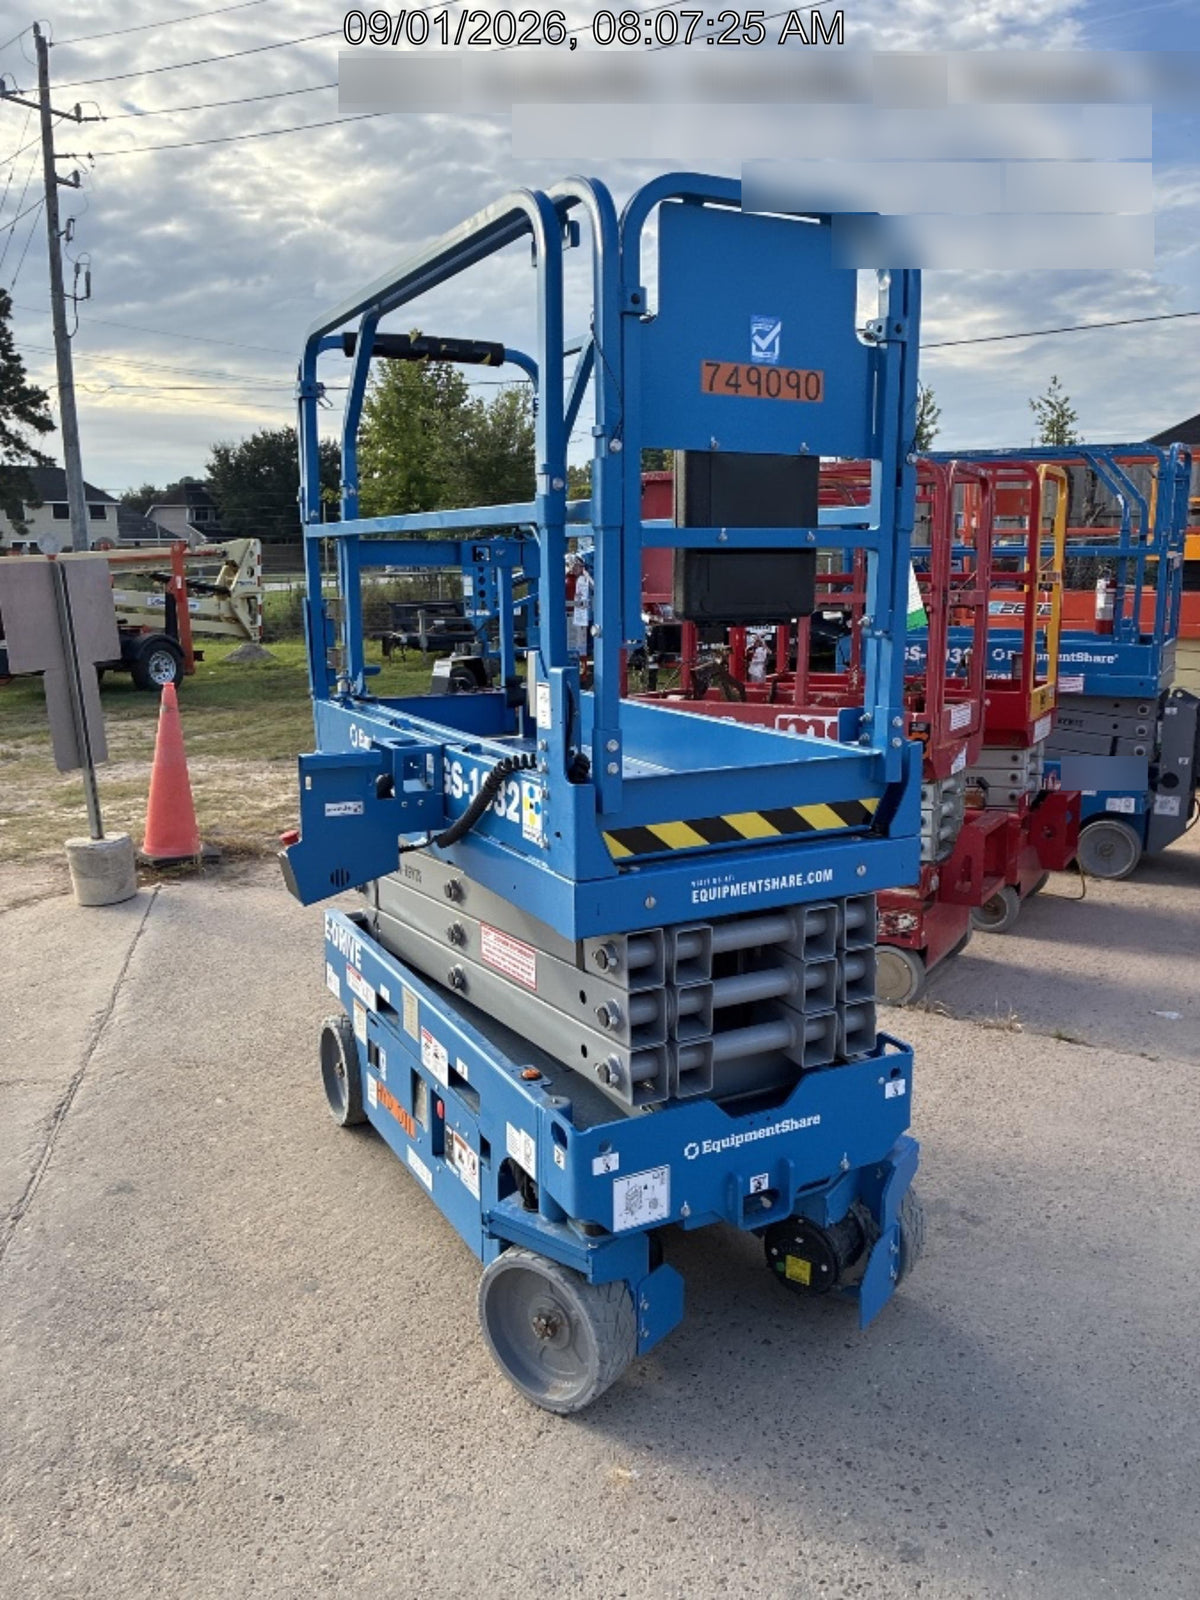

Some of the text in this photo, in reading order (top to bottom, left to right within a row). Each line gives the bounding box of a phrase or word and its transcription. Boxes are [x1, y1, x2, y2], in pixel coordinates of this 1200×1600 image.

[704, 362, 821, 401] 749090
[691, 868, 834, 904] EQUIPMENTSHARE.COM
[702, 1114, 821, 1155] EquipmentShare
